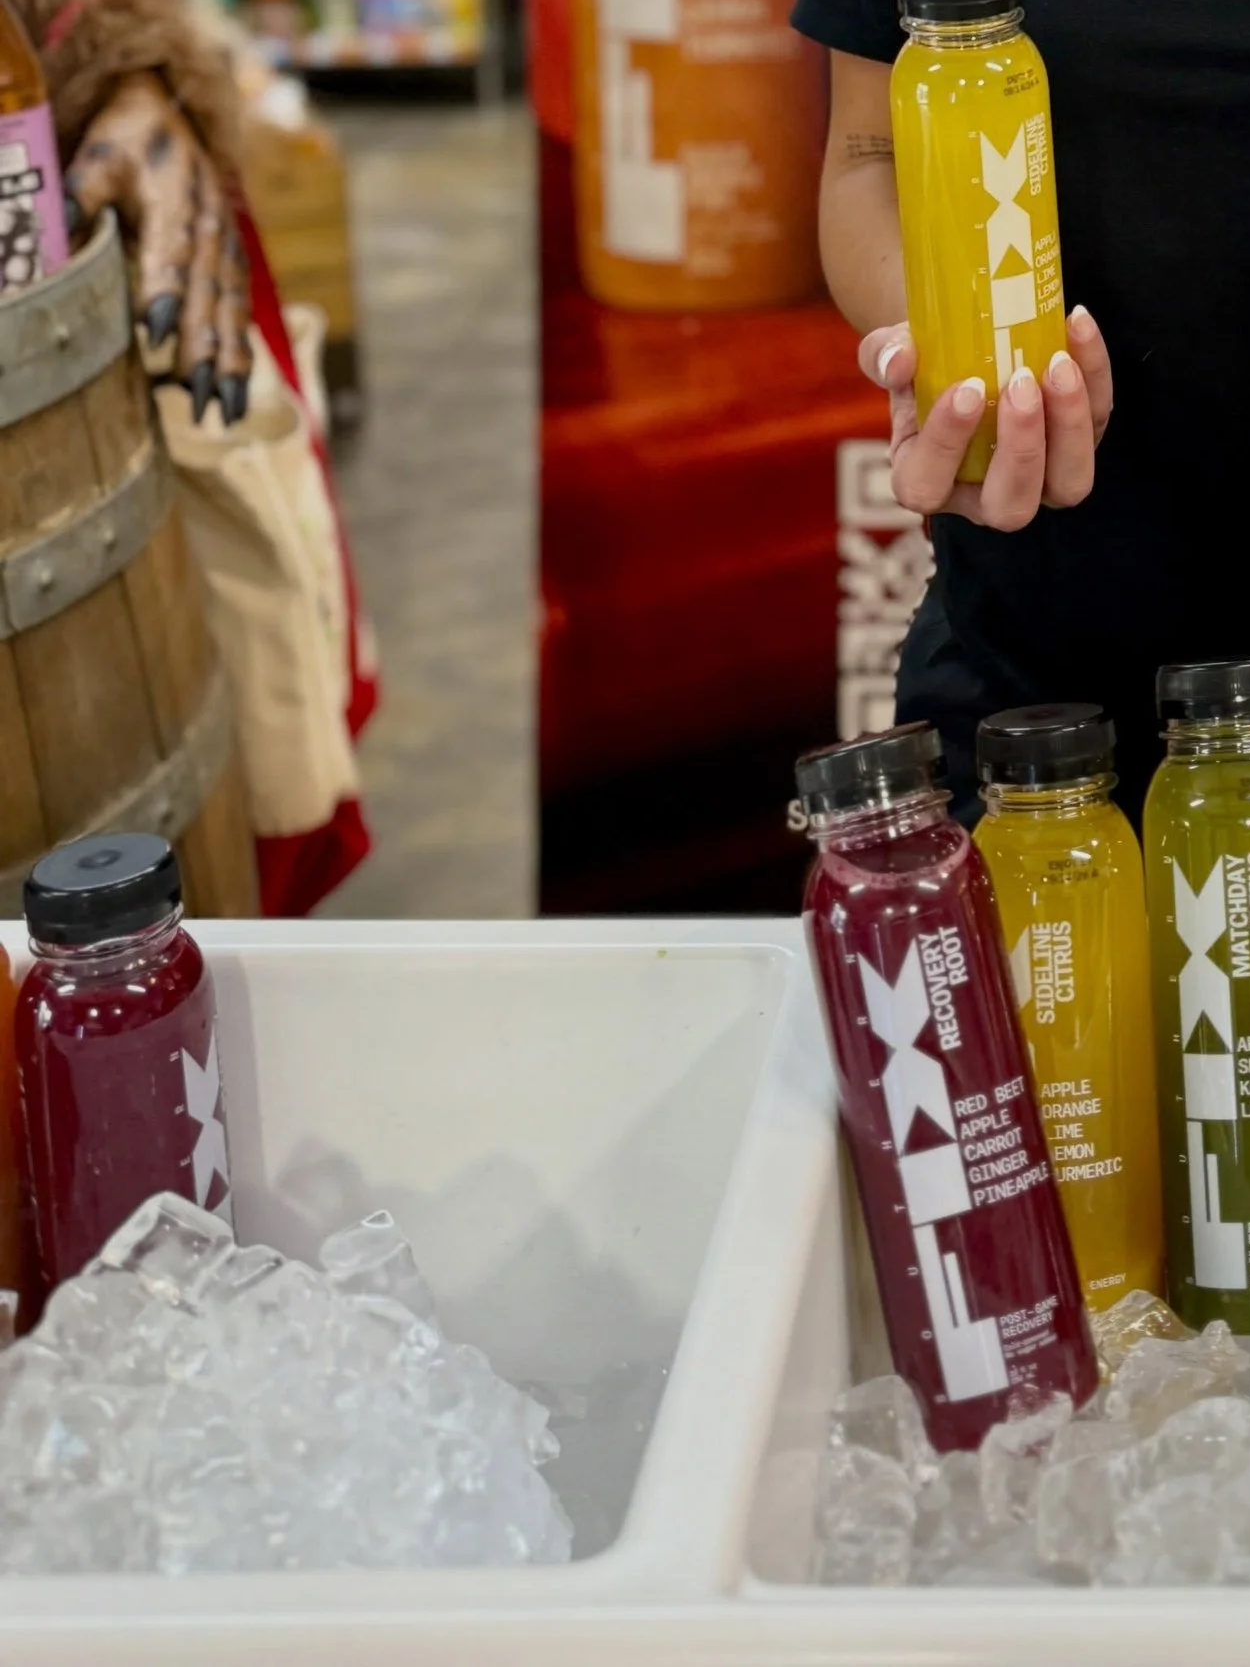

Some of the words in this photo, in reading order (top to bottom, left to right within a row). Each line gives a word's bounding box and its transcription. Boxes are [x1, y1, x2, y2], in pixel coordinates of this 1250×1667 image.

[1026, 118, 1042, 196] SIDELINE
[938, 926, 969, 986] ROOT
[1032, 921, 1056, 1024] SIDELINE
[1052, 920, 1075, 1003] CITRUS
[918, 934, 962, 1051] RECOVERY
[1041, 1078, 1092, 1098] APPLE
[1172, 854, 1248, 1290] FIX
[954, 1094, 987, 1117] RED
[995, 1076, 1025, 1104] BEET
[1041, 1098, 1102, 1119] ORANGE
[960, 1108, 1012, 1140] APPLE
[1048, 1122, 1083, 1140] IME
[964, 1127, 1024, 1161] CARROT
[1055, 1142, 1095, 1161] EMON
[857, 936, 1010, 1402] FIX
[968, 1150, 1029, 1184] GINGER
[973, 1160, 1050, 1206] PINEAPPLE
[1055, 1157, 1123, 1182] URMERIC
[1089, 1273, 1127, 1291] ENERGY
[1000, 1294, 1059, 1327] POST-GAME
[1001, 1312, 1054, 1339] RECOVERY
